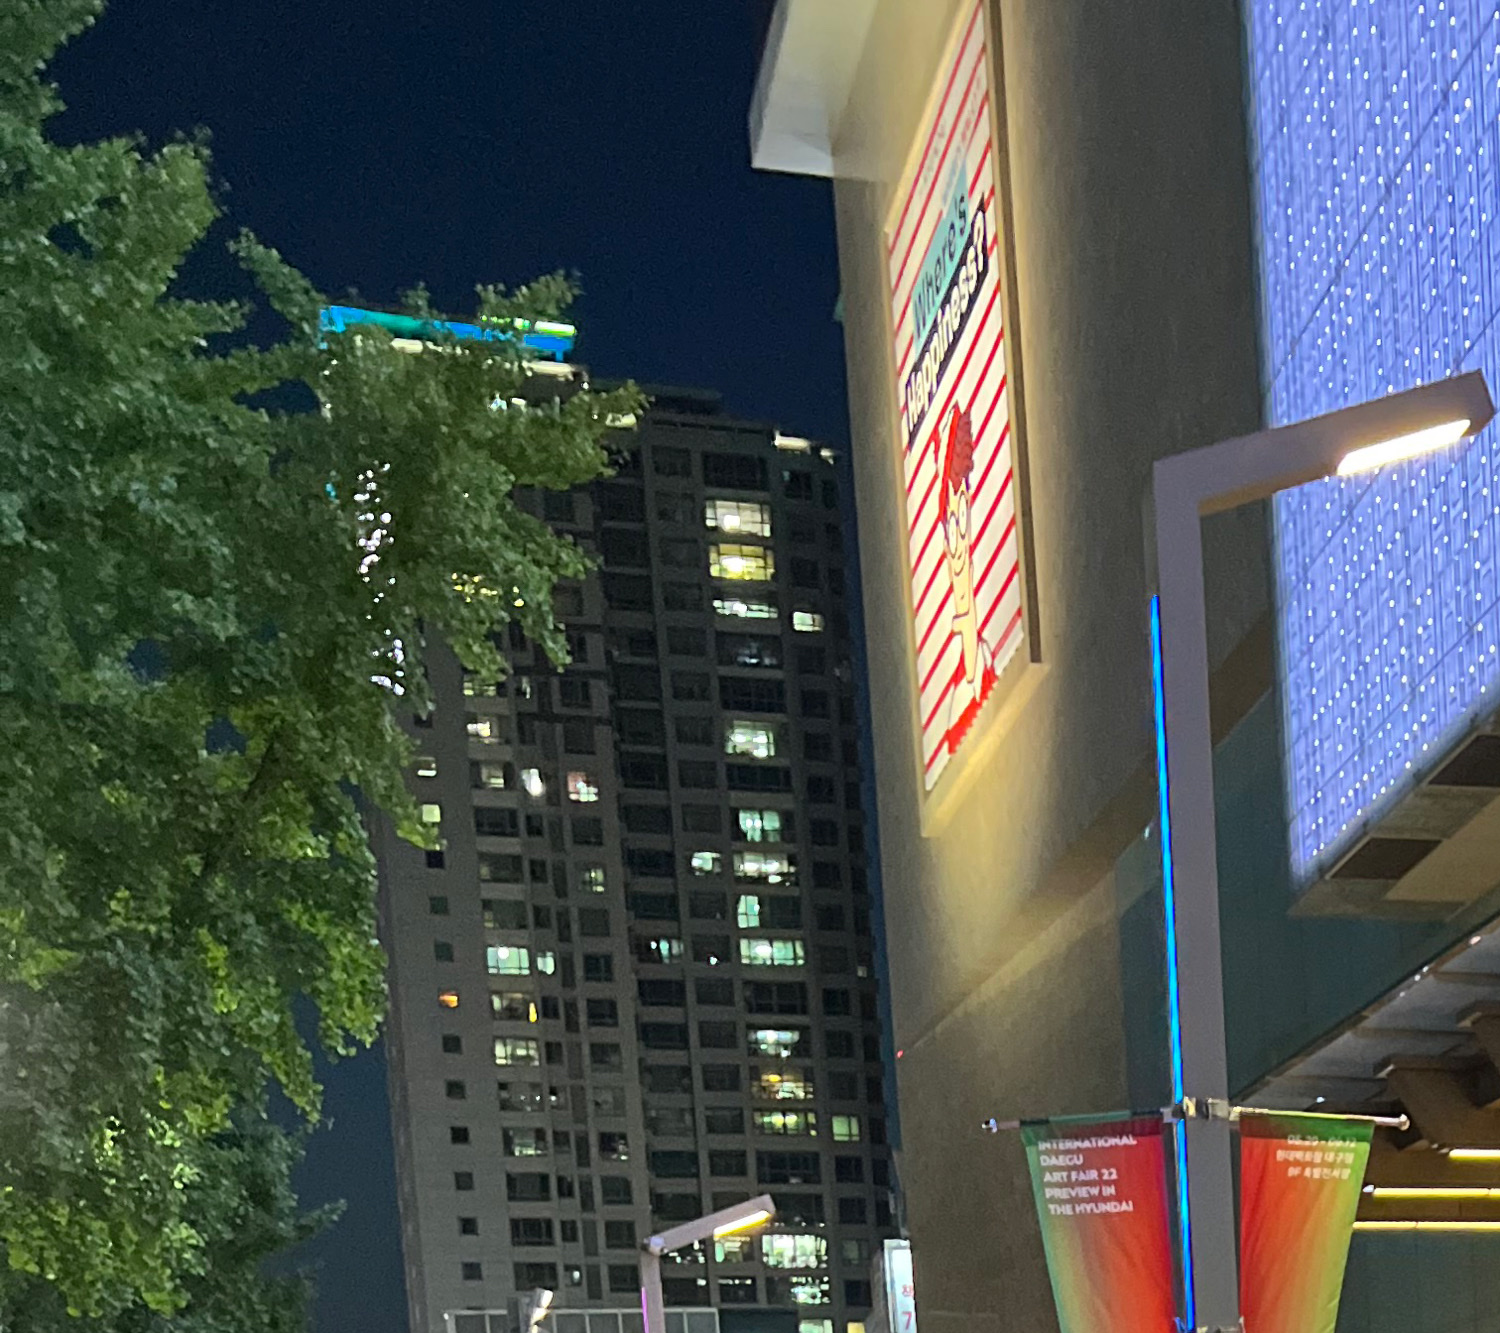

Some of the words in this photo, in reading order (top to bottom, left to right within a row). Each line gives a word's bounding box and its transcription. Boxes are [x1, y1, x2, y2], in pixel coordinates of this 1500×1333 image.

[914, 195, 967, 341] Where's
[905, 210, 985, 434] Happiness?
[1038, 1134, 1137, 1151] INTERNATIONAL
[1040, 1154, 1084, 1167] DAEGU
[1043, 1171, 1069, 1183] ART
[1071, 1169, 1099, 1181] FAIR
[1101, 1167, 1118, 1180] 22
[1045, 1186, 1100, 1199] PREVIEW
[1101, 1184, 1116, 1197] IN
[1048, 1203, 1074, 1216] THE
[1075, 1200, 1134, 1215] HYUNDAI
